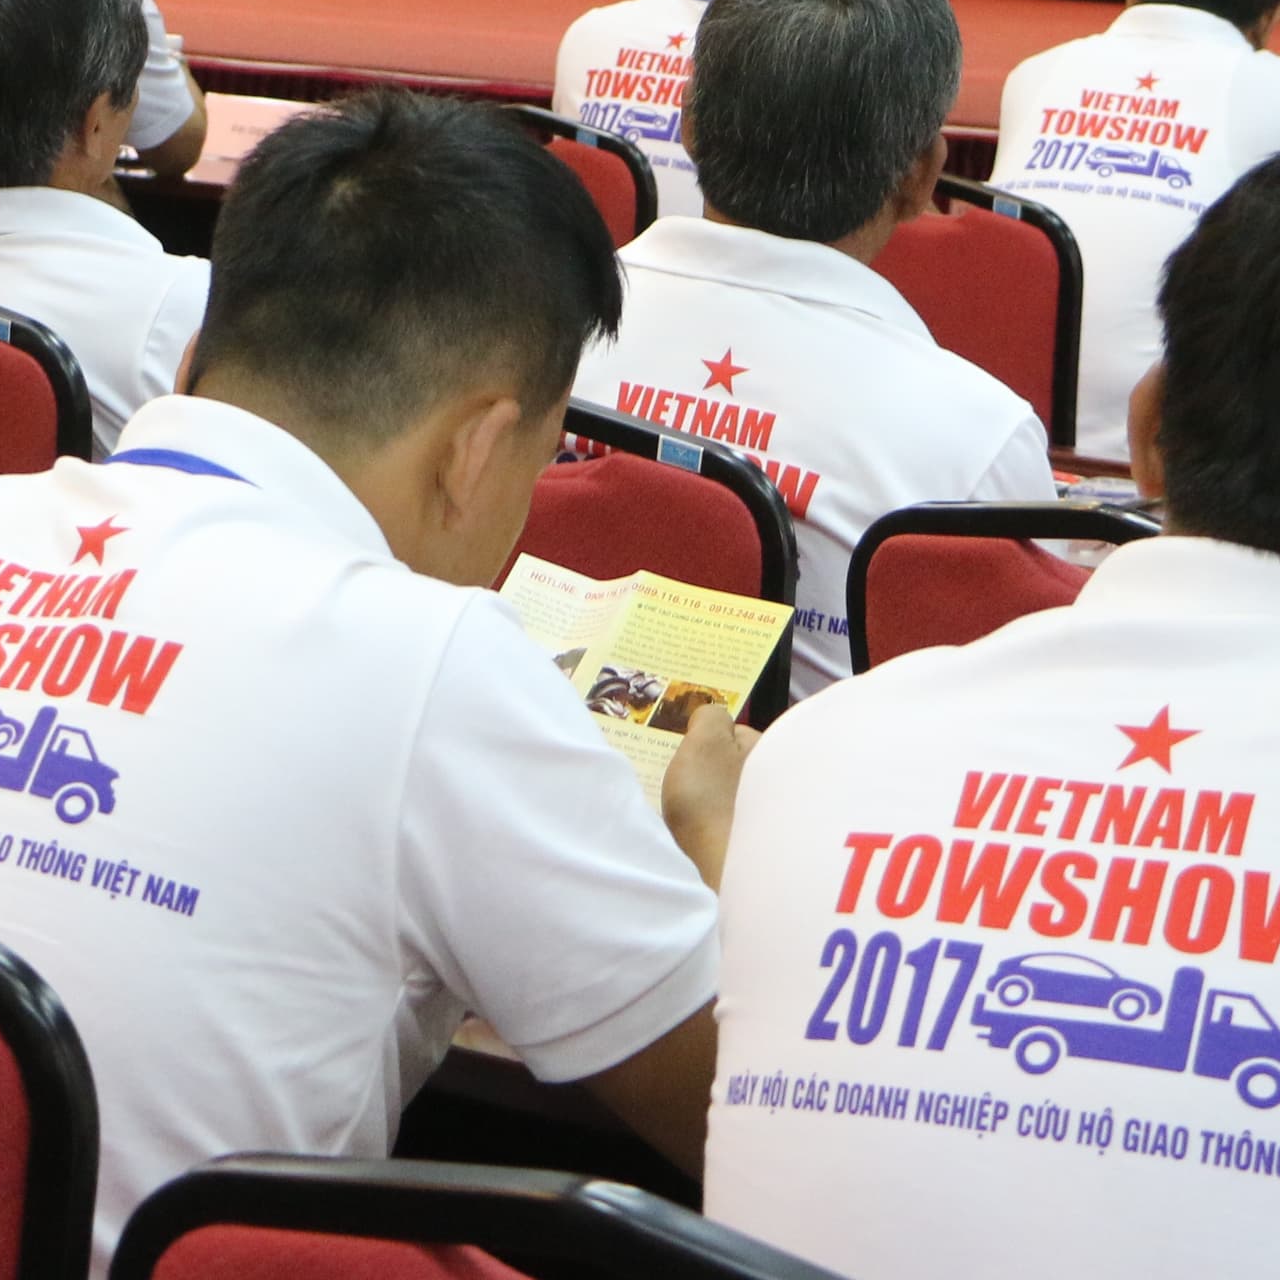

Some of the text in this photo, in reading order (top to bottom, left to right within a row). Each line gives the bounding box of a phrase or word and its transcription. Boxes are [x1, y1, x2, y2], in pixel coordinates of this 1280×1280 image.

[585, 69, 688, 108] TOWSHO
[1080, 88, 1180, 119] VIETNAM
[1025, 138, 1089, 171] 2017
[1040, 108, 1209, 155] TOWSHOW
[616, 381, 777, 452] VIETNAM
[530, 571, 577, 594] HOTLINE
[828, 616, 848, 636] NA
[953, 770, 1255, 856] VIETNAM
[16, 837, 87, 882] THÔNG
[91, 859, 141, 900] VIỆT
[142, 873, 200, 917] NAM
[805, 928, 984, 1051] 2017
[759, 1070, 789, 1114] HỘI
[792, 1072, 829, 1111] CÁC
[834, 1081, 909, 1121] DOANH
[915, 1089, 1009, 1139] NGHIỆP
[1017, 1097, 1068, 1142] CỨU
[1077, 1106, 1113, 1157] HỘ
[1122, 1117, 1189, 1161] GIAO
